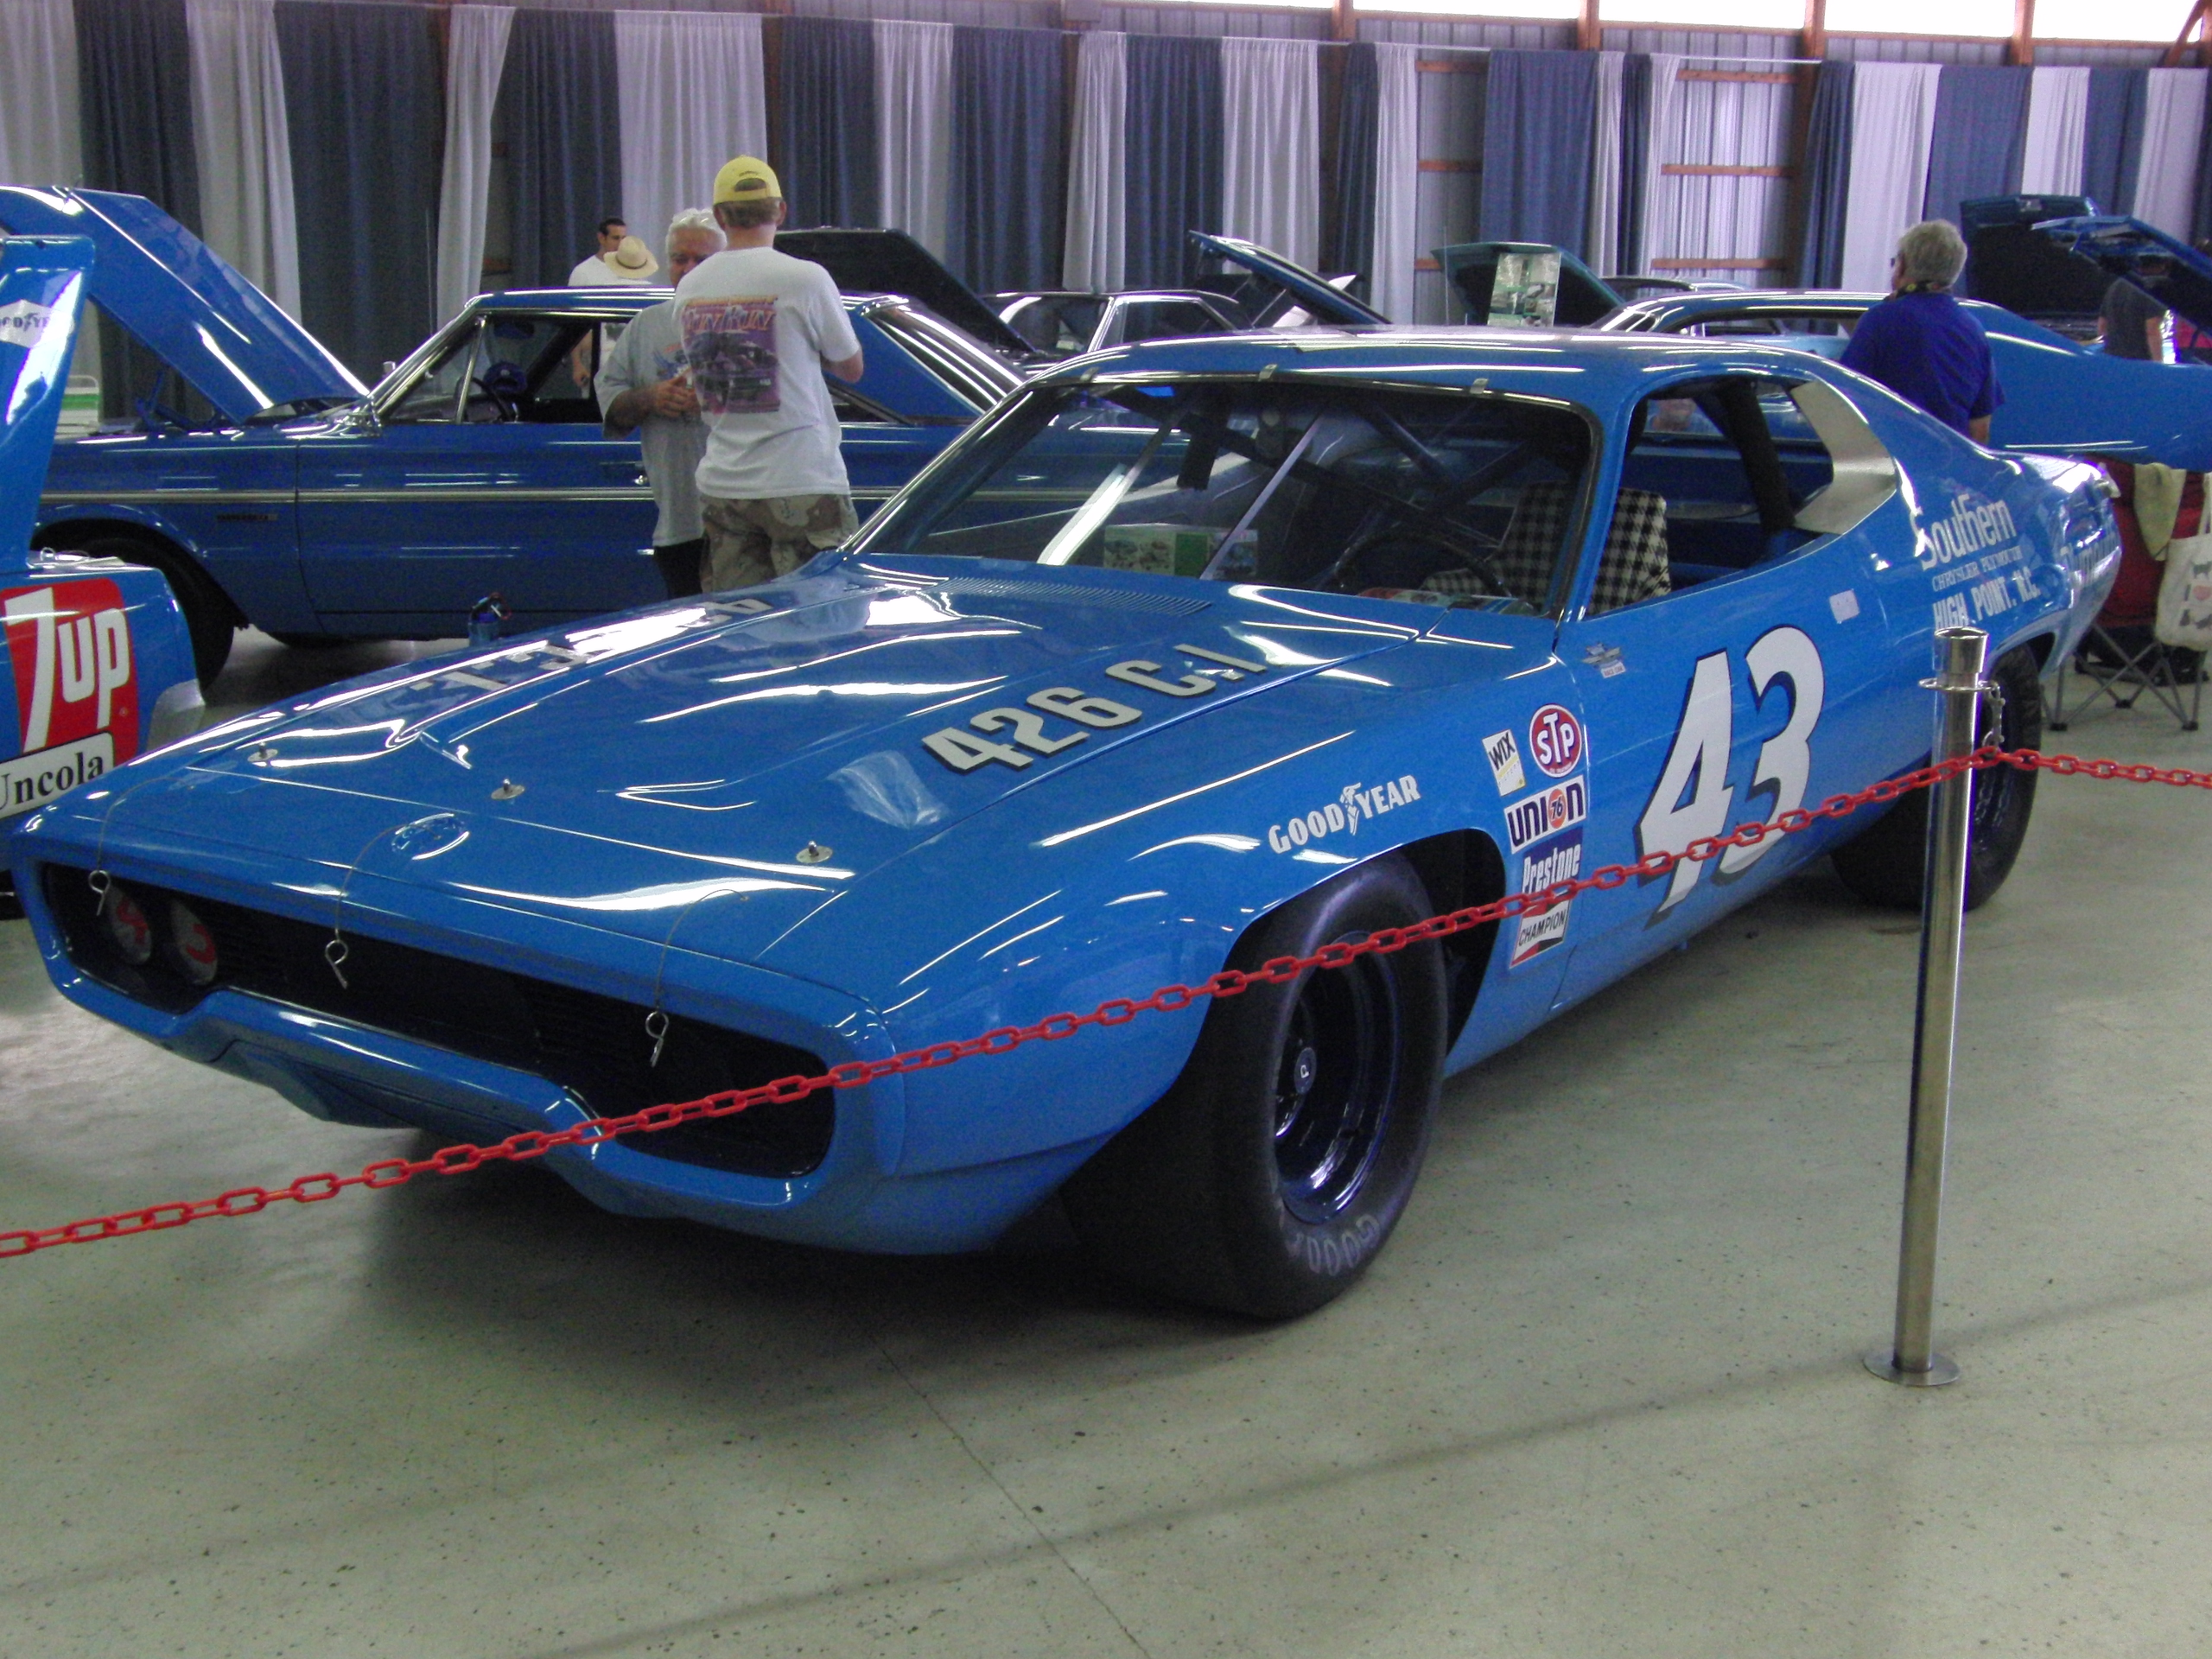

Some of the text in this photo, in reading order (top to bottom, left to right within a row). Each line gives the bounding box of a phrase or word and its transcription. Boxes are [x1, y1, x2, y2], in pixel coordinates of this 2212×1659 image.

[1910, 493, 2018, 571] Southern
[1932, 592, 1970, 631] HIGH
[922, 686, 1142, 774] 426
[1488, 731, 1516, 772] WIX
[1536, 712, 1575, 766] STP
[1634, 623, 1826, 919] 43
[1268, 774, 1421, 854] GOODYEAR
[1522, 843, 1582, 895] Prestone
[1518, 908, 1566, 947] CHAMPION
